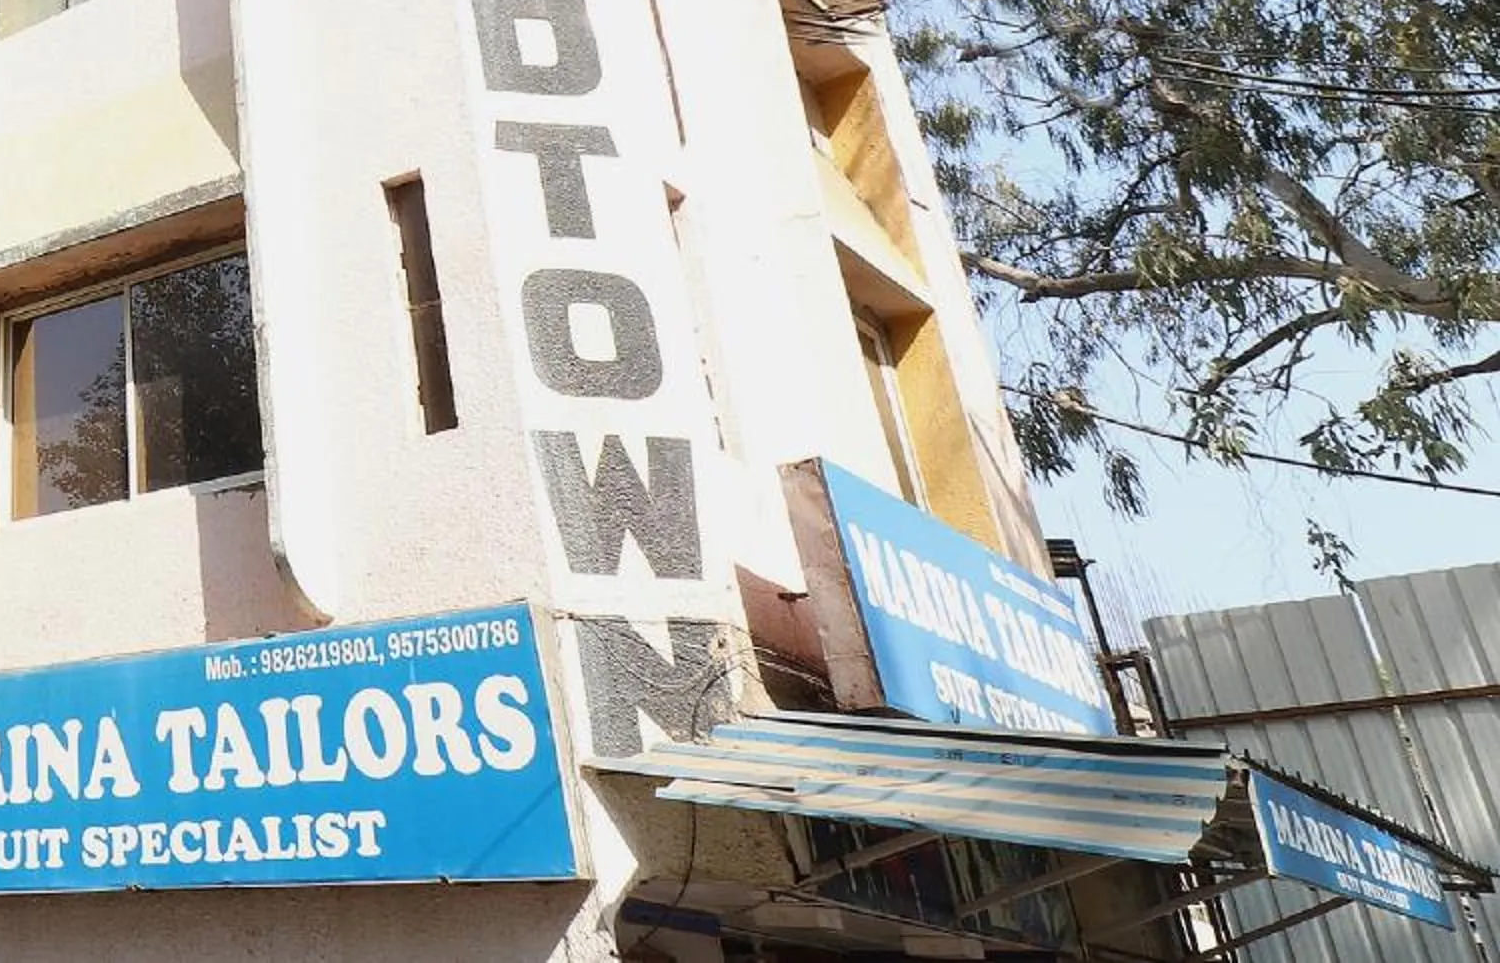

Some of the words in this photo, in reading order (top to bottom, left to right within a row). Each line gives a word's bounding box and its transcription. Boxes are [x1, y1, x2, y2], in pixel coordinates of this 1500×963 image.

[260, 639, 384, 674] 9826219801,
[388, 618, 520, 661] 9575300786
[848, 522, 997, 661] MARINA
[983, 590, 1102, 709] TAILORS
[930, 659, 987, 719] SUIT
[156, 673, 537, 794] TAILORS
[81, 810, 386, 868] SPECIALIST
[1267, 800, 1367, 875] MARINA
[1361, 839, 1443, 903] TAILORS
